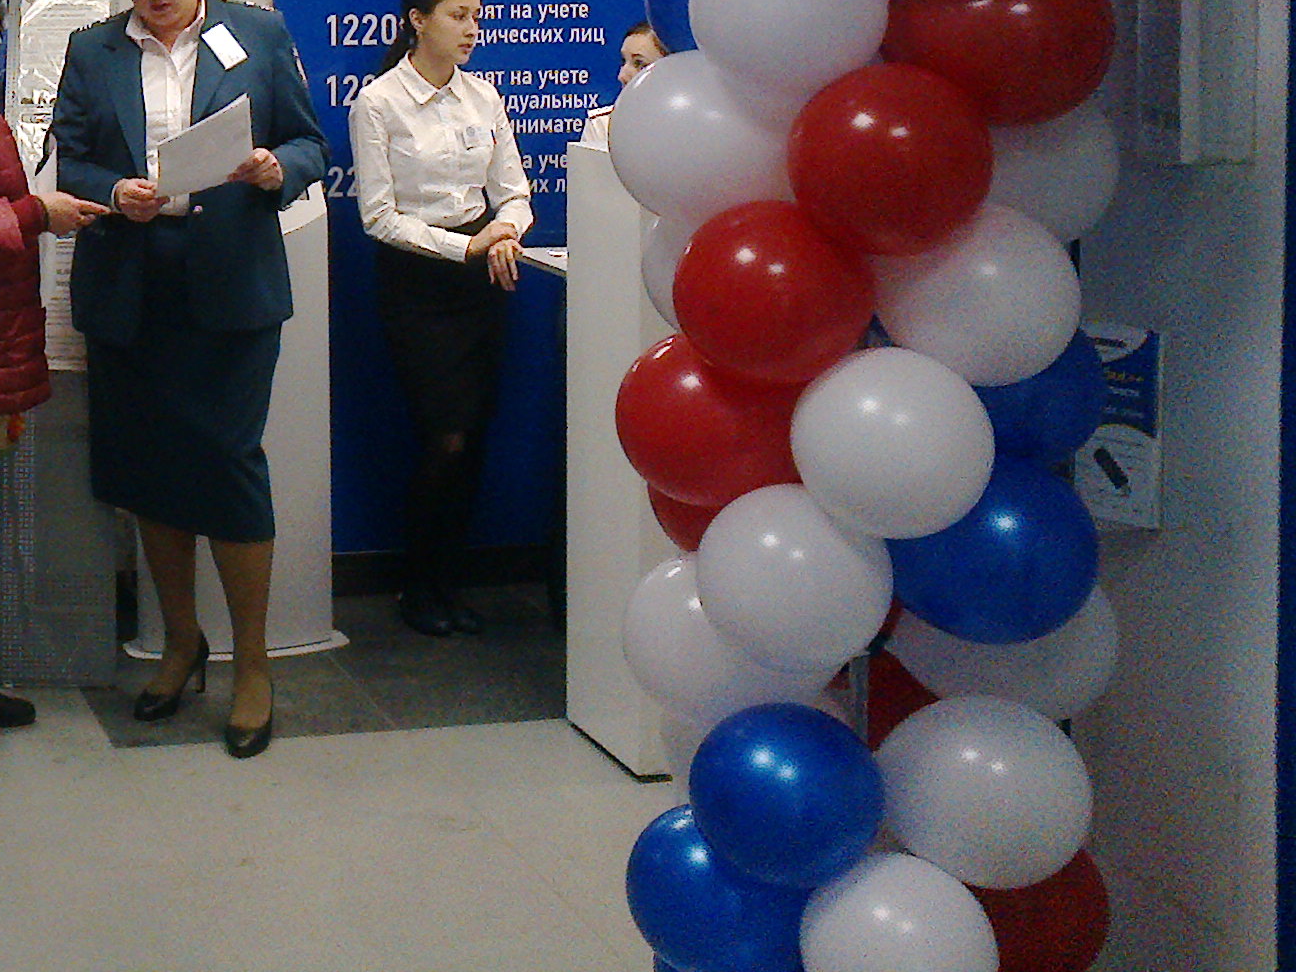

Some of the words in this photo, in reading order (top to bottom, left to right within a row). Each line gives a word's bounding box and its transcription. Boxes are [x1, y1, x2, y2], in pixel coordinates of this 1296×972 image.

[510, 4, 532, 19] на
[538, 3, 589, 24] учете
[326, 13, 404, 47] 1220
[568, 28, 605, 45] лиц
[326, 73, 375, 107] 12
[510, 70, 532, 85] на
[538, 70, 589, 90] учете
